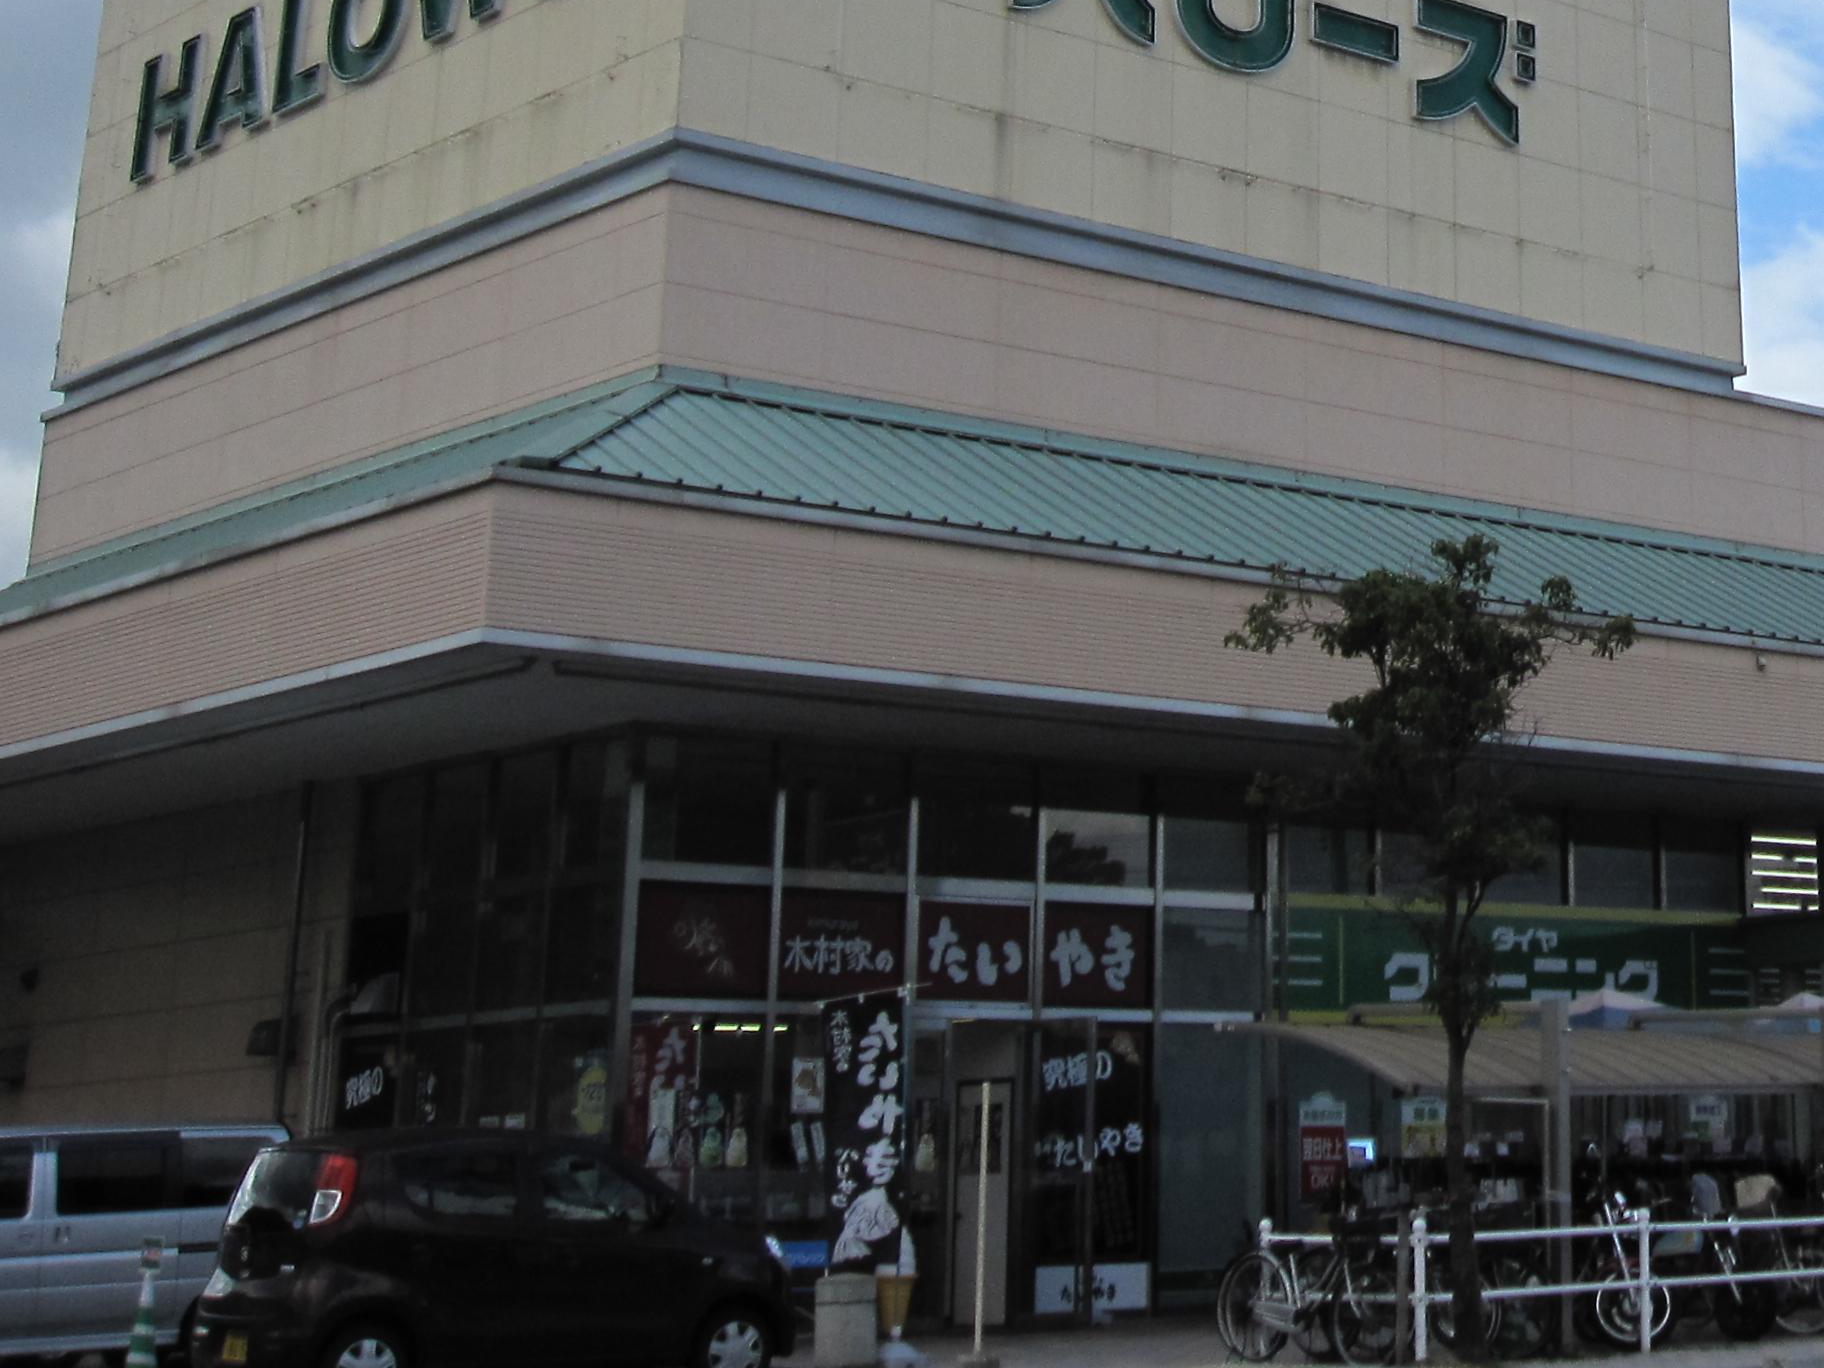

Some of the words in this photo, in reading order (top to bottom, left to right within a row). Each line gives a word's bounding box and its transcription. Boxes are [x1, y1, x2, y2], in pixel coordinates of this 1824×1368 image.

[784, 934, 895, 975] 木村家の
[928, 915, 1136, 992] たいやき
[1492, 926, 1559, 952] ダイヤ
[1384, 952, 1661, 1003] クーニング
